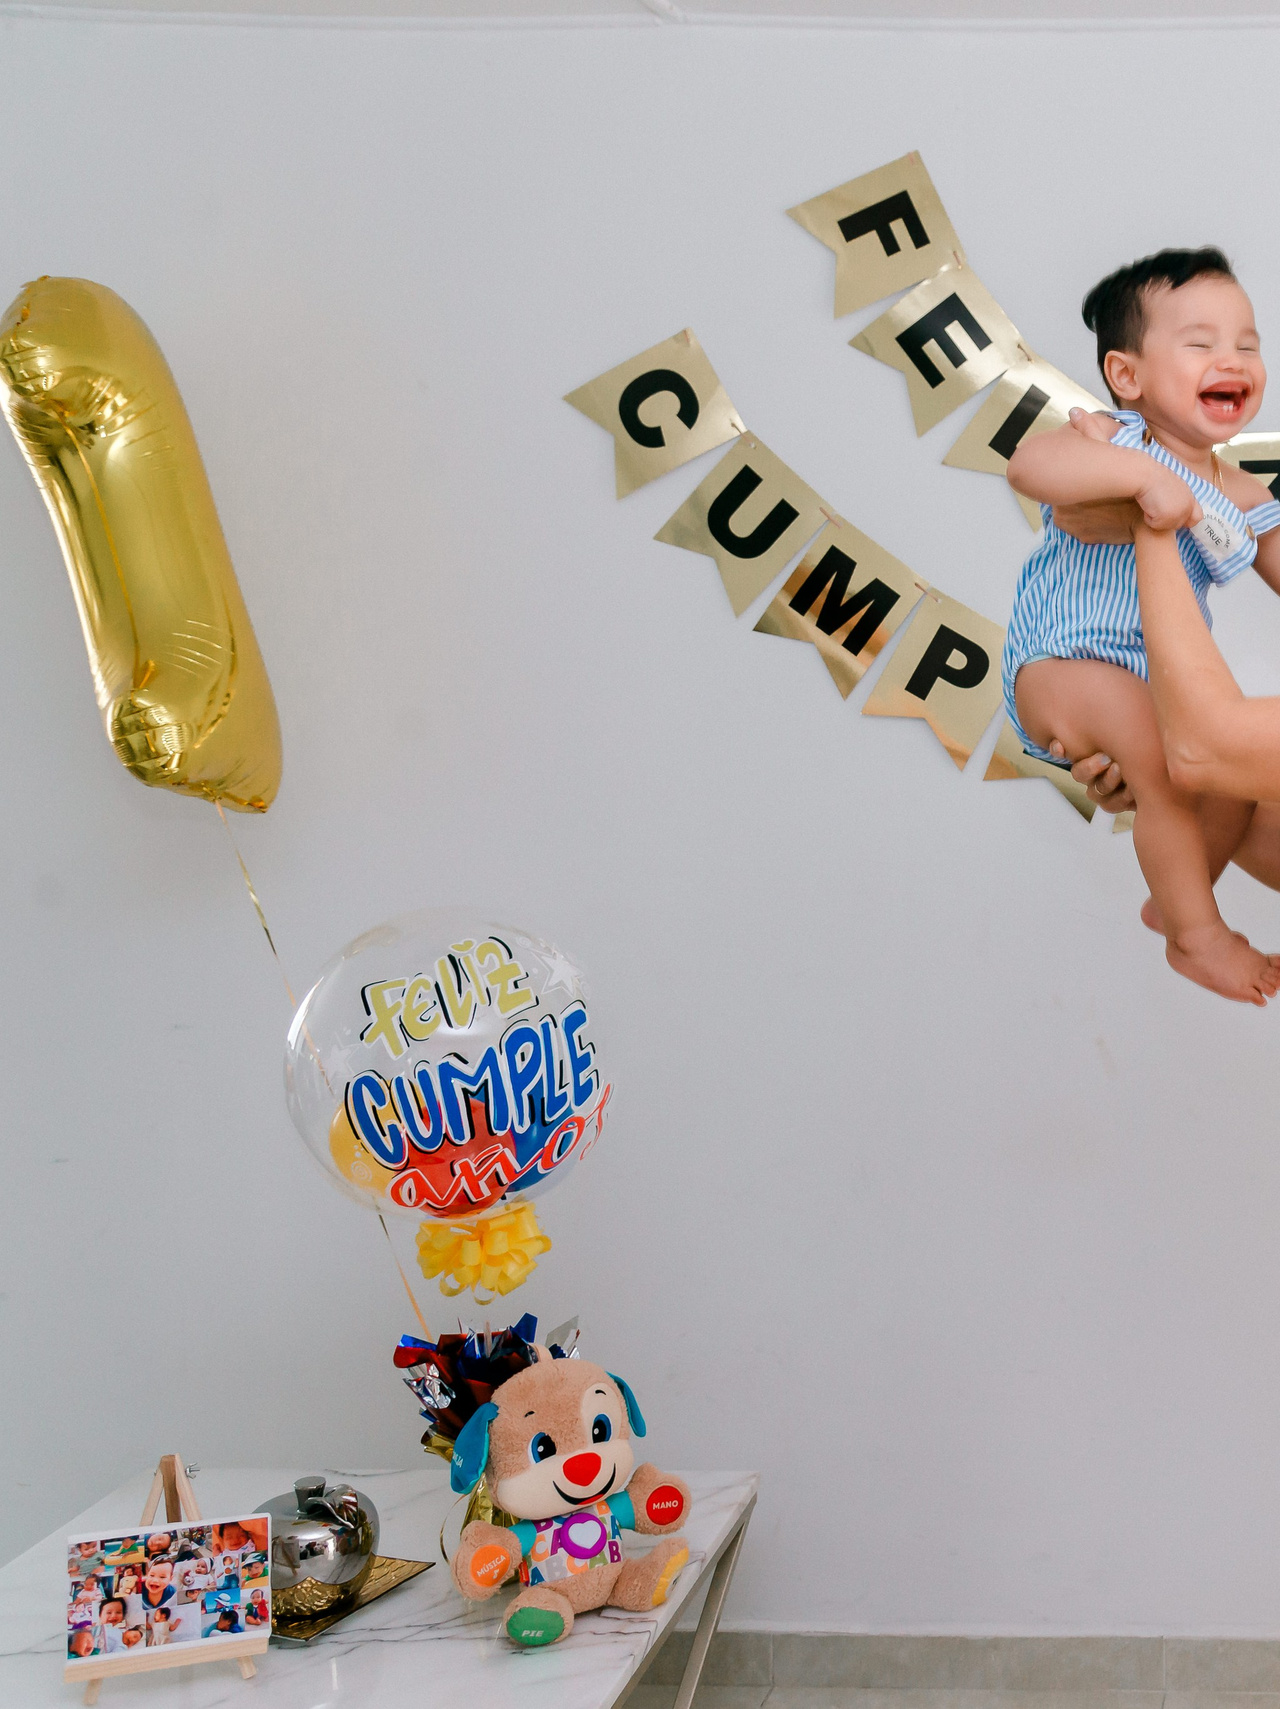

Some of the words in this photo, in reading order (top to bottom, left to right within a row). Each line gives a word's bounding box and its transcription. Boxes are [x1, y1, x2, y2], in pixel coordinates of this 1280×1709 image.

[1204, 524, 1223, 546] TRUE
[345, 1000, 599, 1171] CUMPLE
[652, 1499, 679, 1510] MANO
[476, 1554, 506, 1577] MÚSICA
[521, 1629, 545, 1638] PIE
